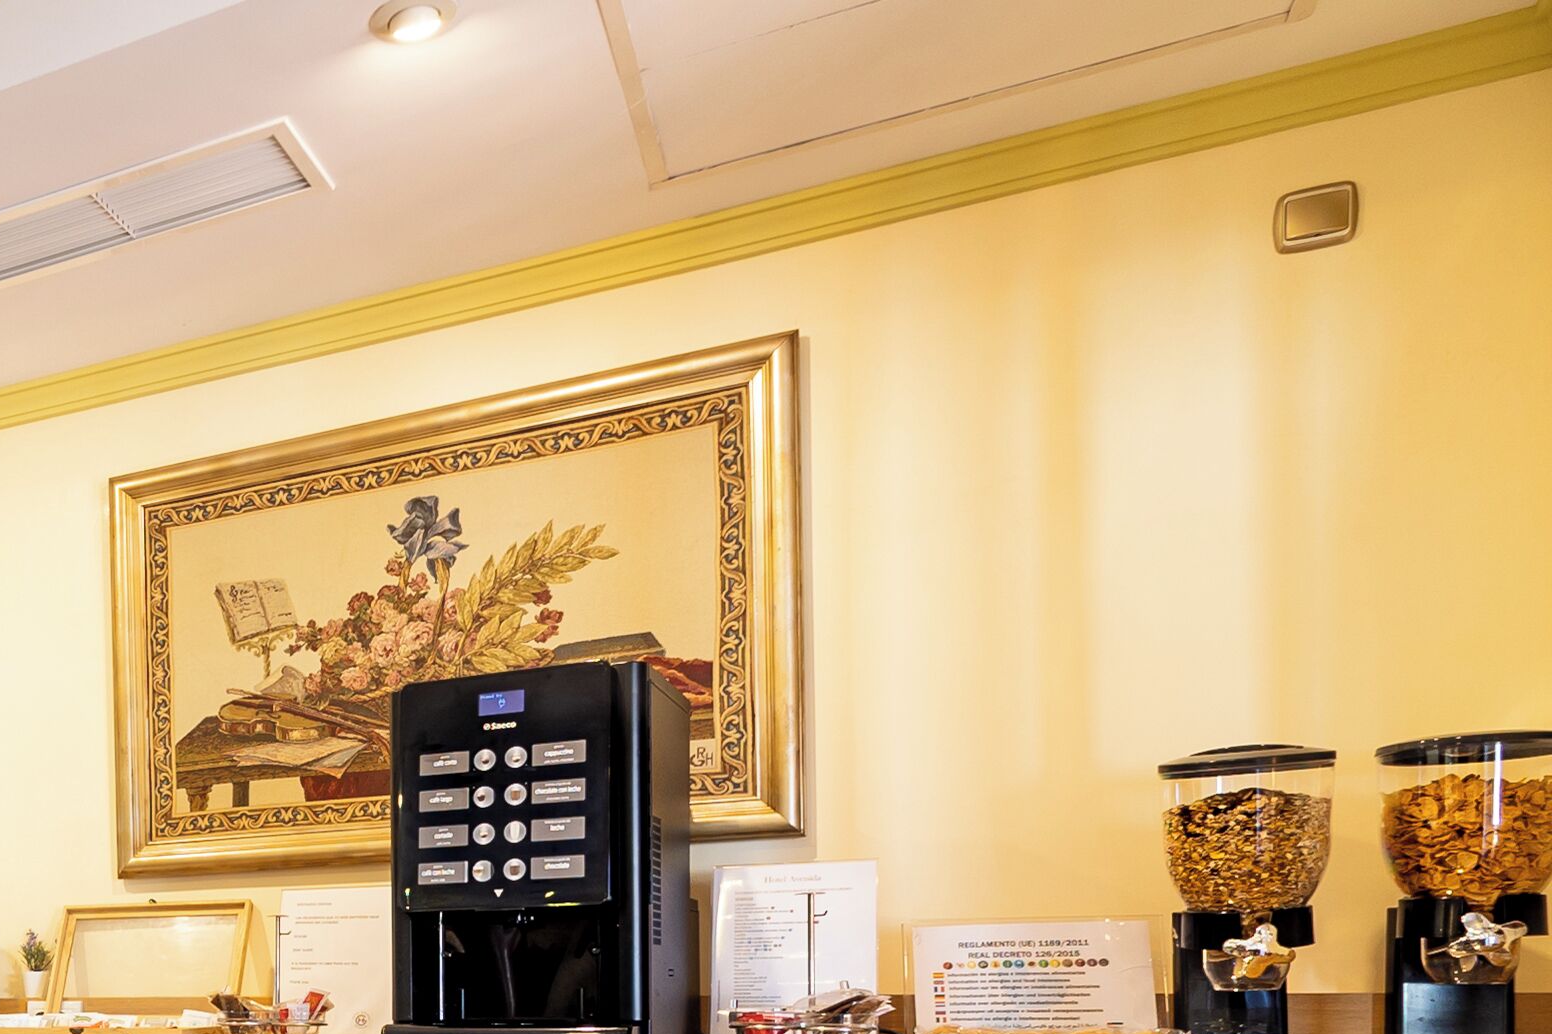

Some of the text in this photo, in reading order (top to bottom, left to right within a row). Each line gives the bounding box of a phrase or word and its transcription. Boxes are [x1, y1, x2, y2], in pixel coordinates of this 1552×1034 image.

[491, 721, 517, 731] Saeco
[957, 940, 1016, 949] REGLAMENTO
[1017, 940, 1036, 949] (UE)
[967, 949, 1081, 959] REAL DECRETO 126/2015
